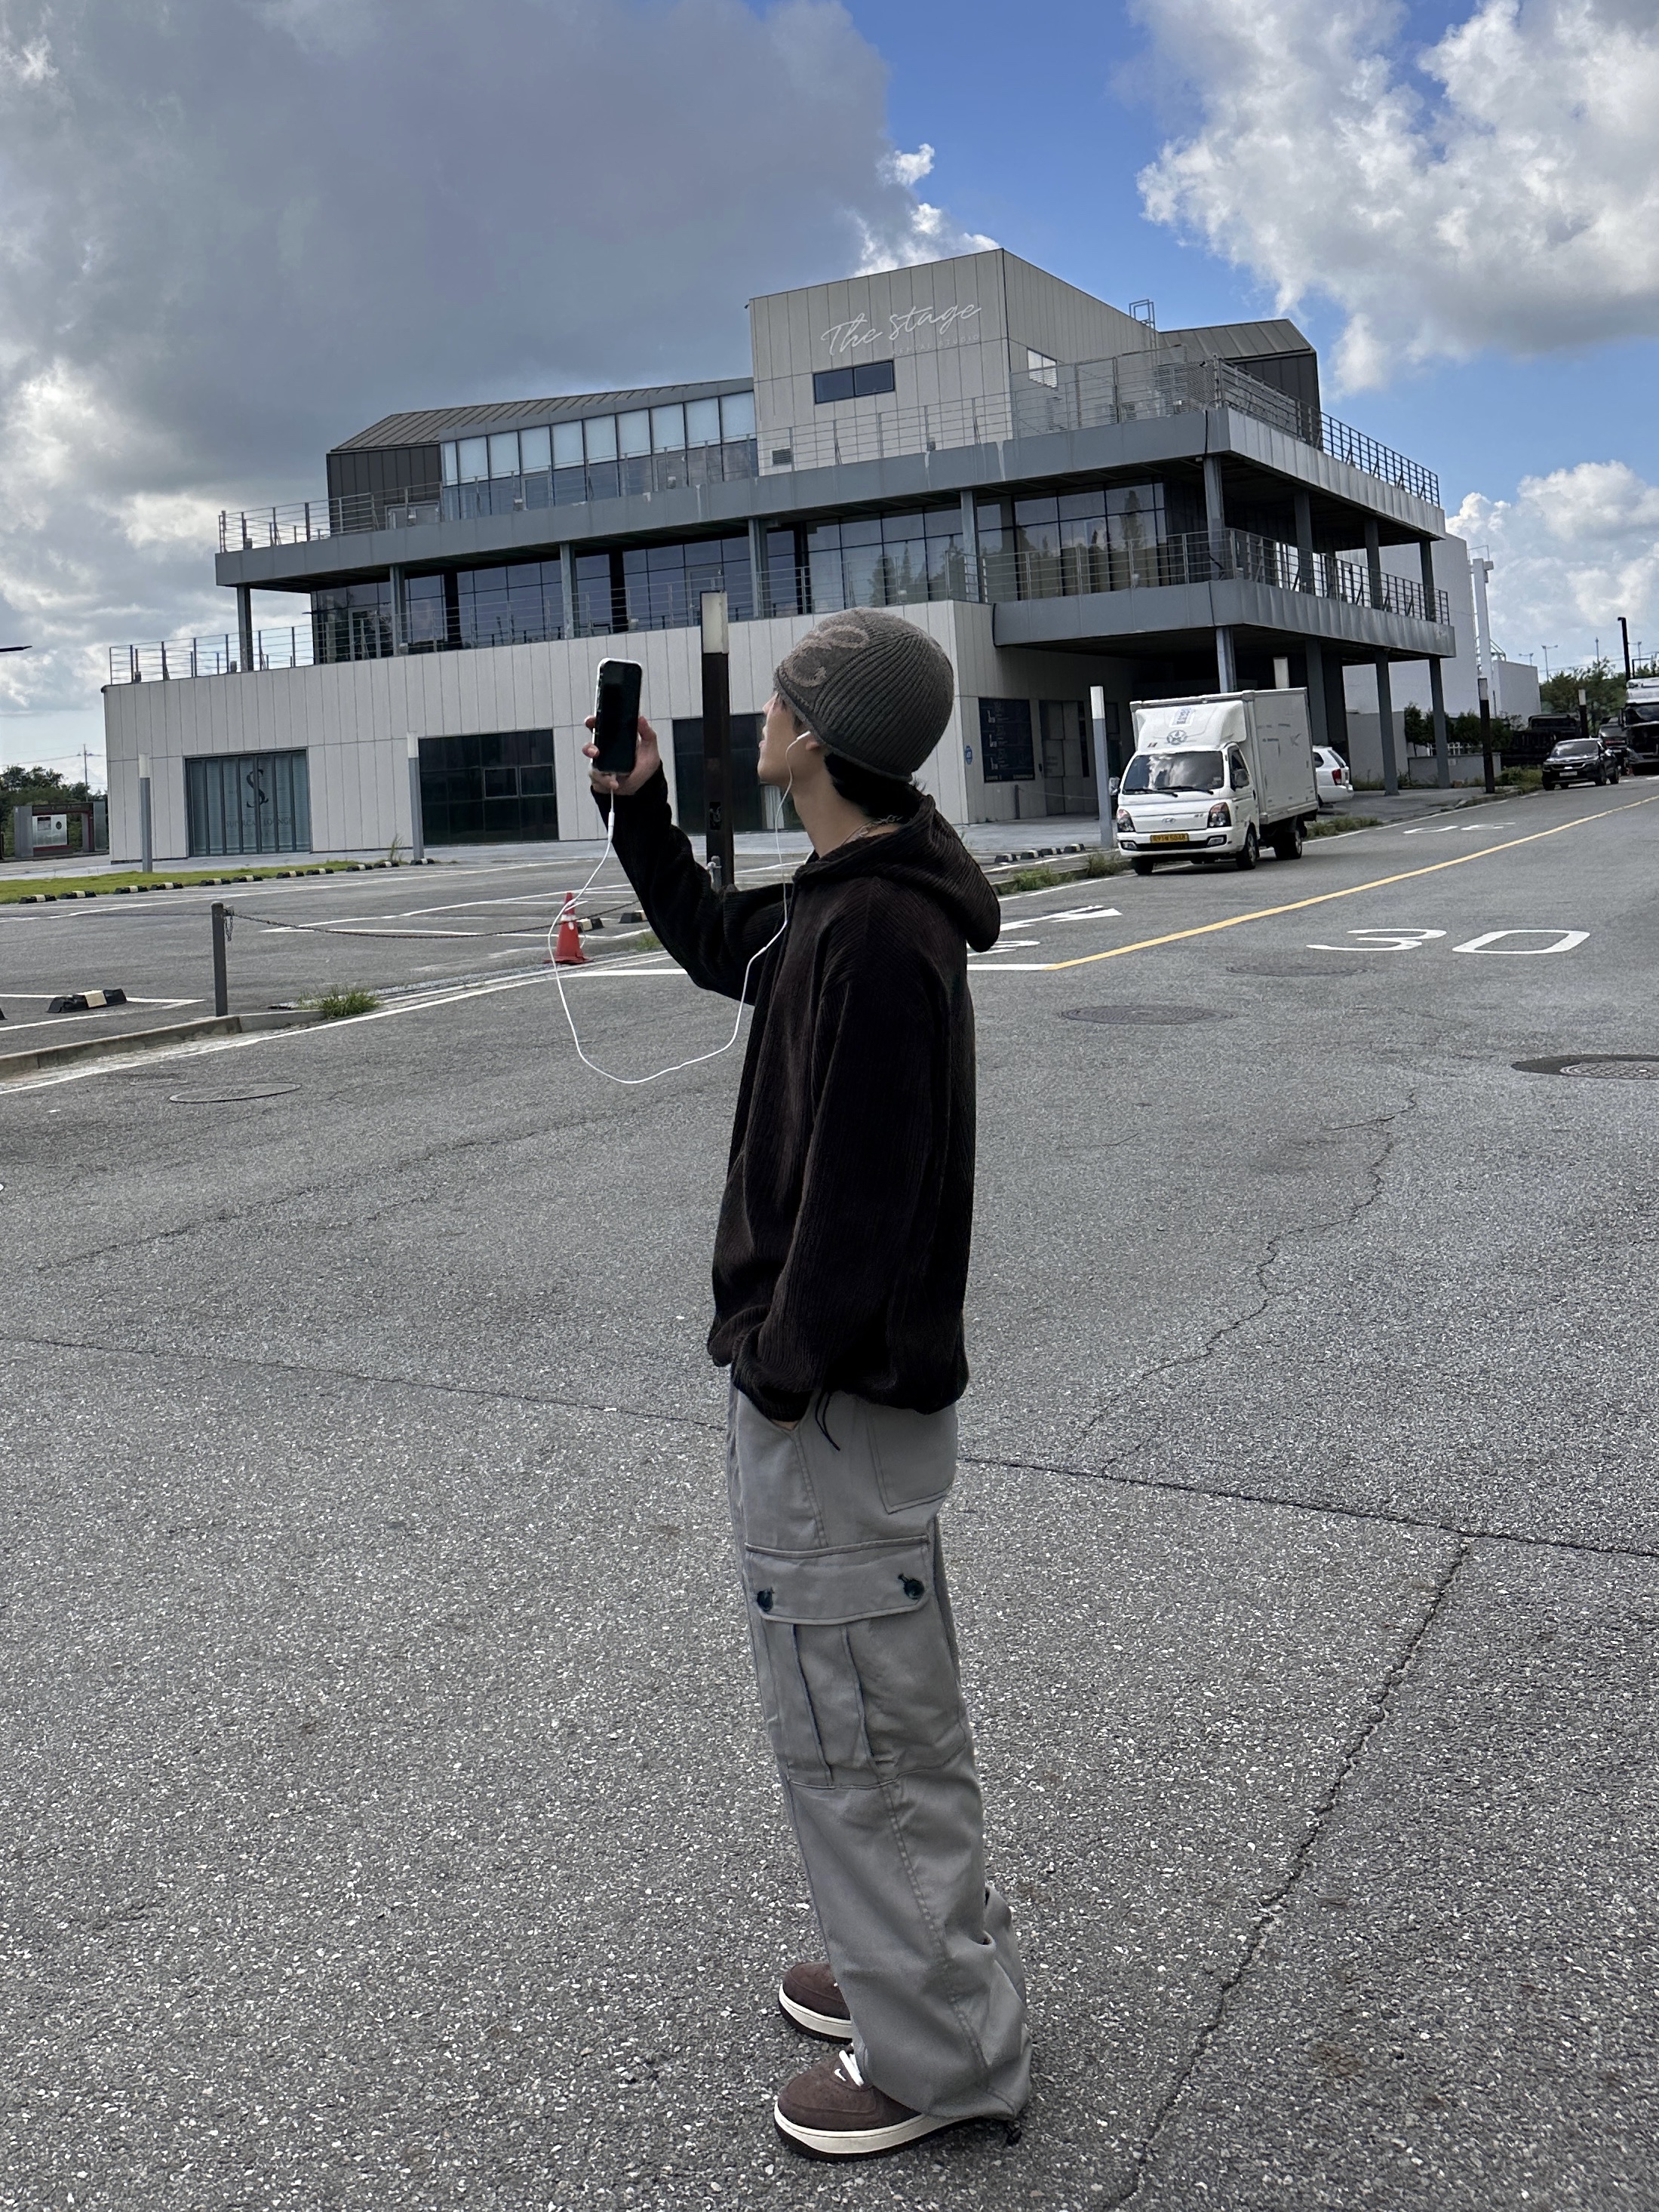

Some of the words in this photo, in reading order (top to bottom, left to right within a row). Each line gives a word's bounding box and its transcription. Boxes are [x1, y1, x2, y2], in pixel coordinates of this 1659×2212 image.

[820, 312, 883, 355] The
[938, 333, 980, 347] STUDIO
[1306, 928, 1591, 955] 30
